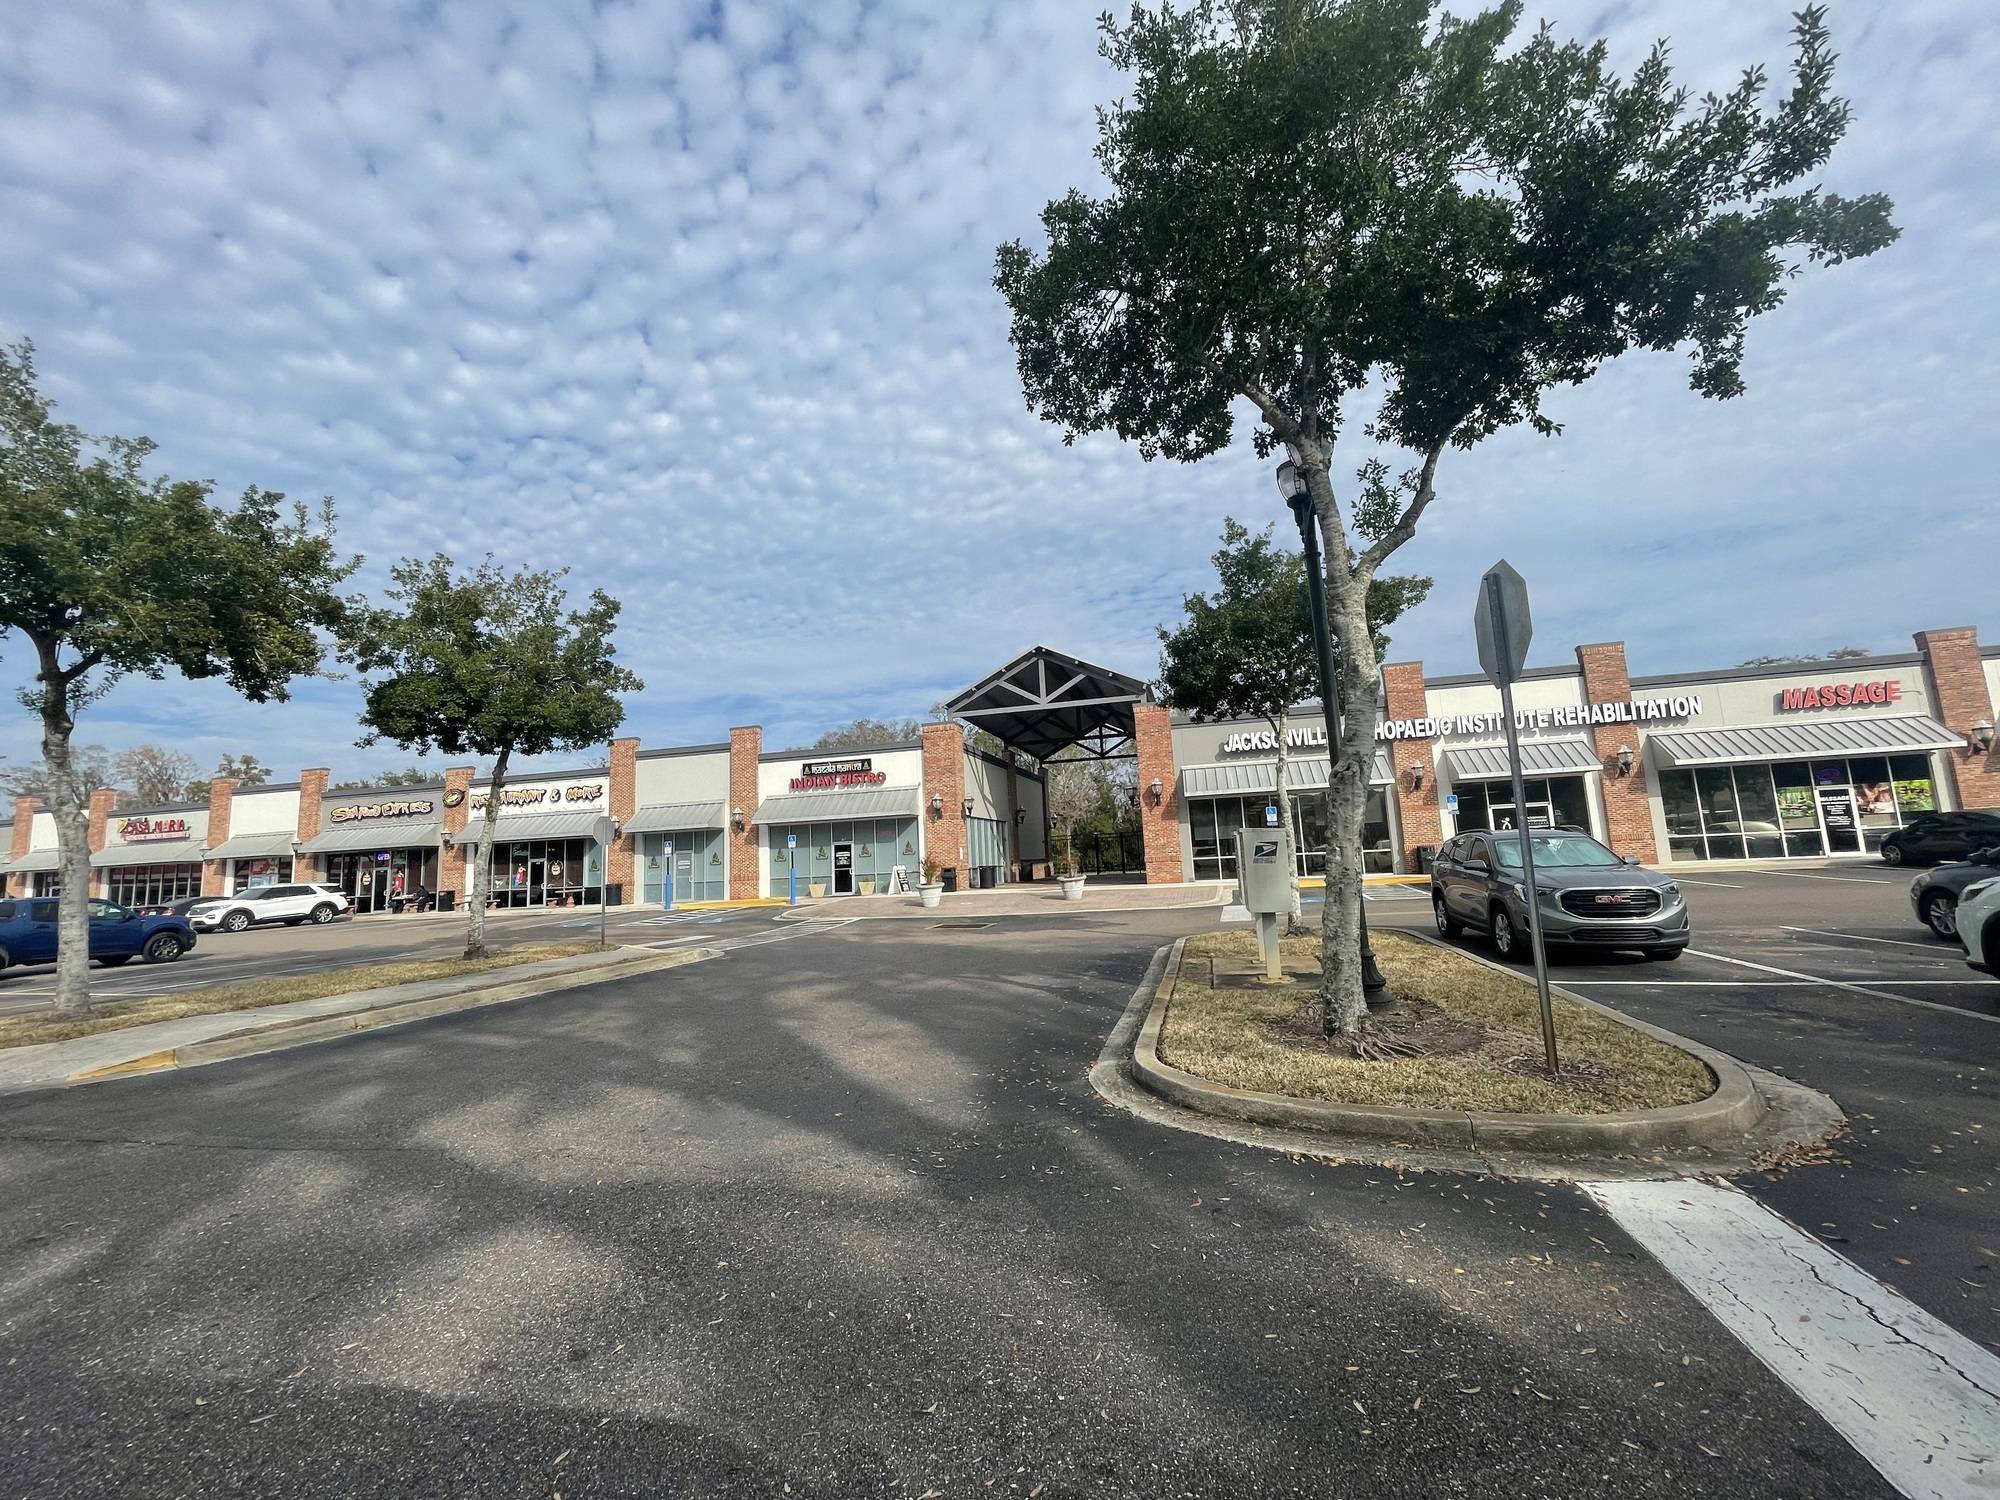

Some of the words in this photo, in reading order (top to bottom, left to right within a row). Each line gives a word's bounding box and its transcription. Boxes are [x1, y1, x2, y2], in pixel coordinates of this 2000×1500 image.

[1781, 680, 1903, 710] MASSAGE
[1224, 726, 1328, 752] JACKSONVILL
[1341, 716, 1452, 741] HOPAEDIC
[1456, 708, 1549, 734] INSTIUTE
[1552, 695, 1703, 726] REHABILITATION
[789, 775, 837, 790] INDIAN
[839, 771, 887, 786] BISTRO
[549, 789, 560, 802] &
[565, 785, 603, 801] MORE
[381, 801, 433, 816] EXPRESS
[1595, 895, 1631, 904] GMC
